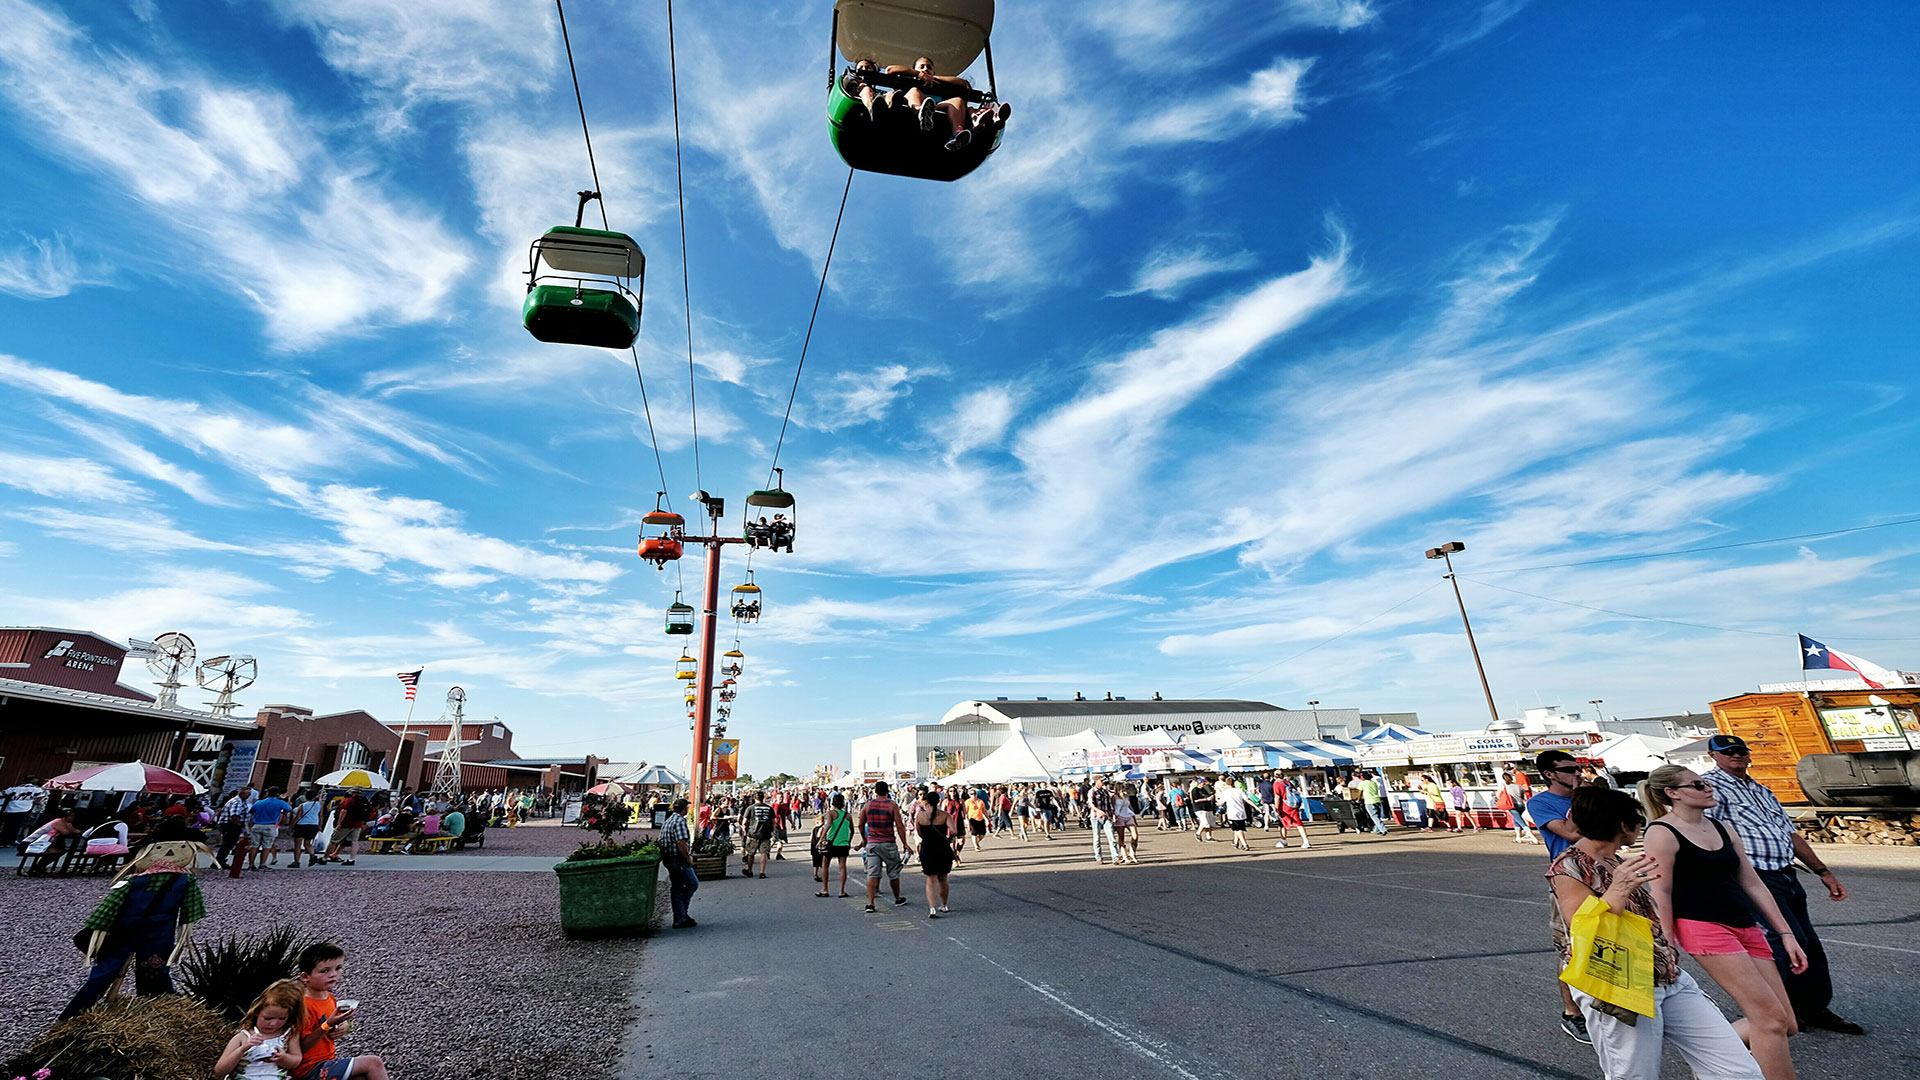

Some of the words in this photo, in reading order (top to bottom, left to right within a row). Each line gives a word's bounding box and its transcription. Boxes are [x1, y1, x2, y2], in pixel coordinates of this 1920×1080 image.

[66, 649, 81, 660] FIVE
[80, 652, 102, 664] POINTS
[101, 656, 118, 667] BANK
[65, 660, 95, 671] ARENA
[1133, 724, 1192, 732] HEARTLAND
[1561, 737, 1586, 746] Dogs
[1121, 748, 1151, 756] JUMBO
